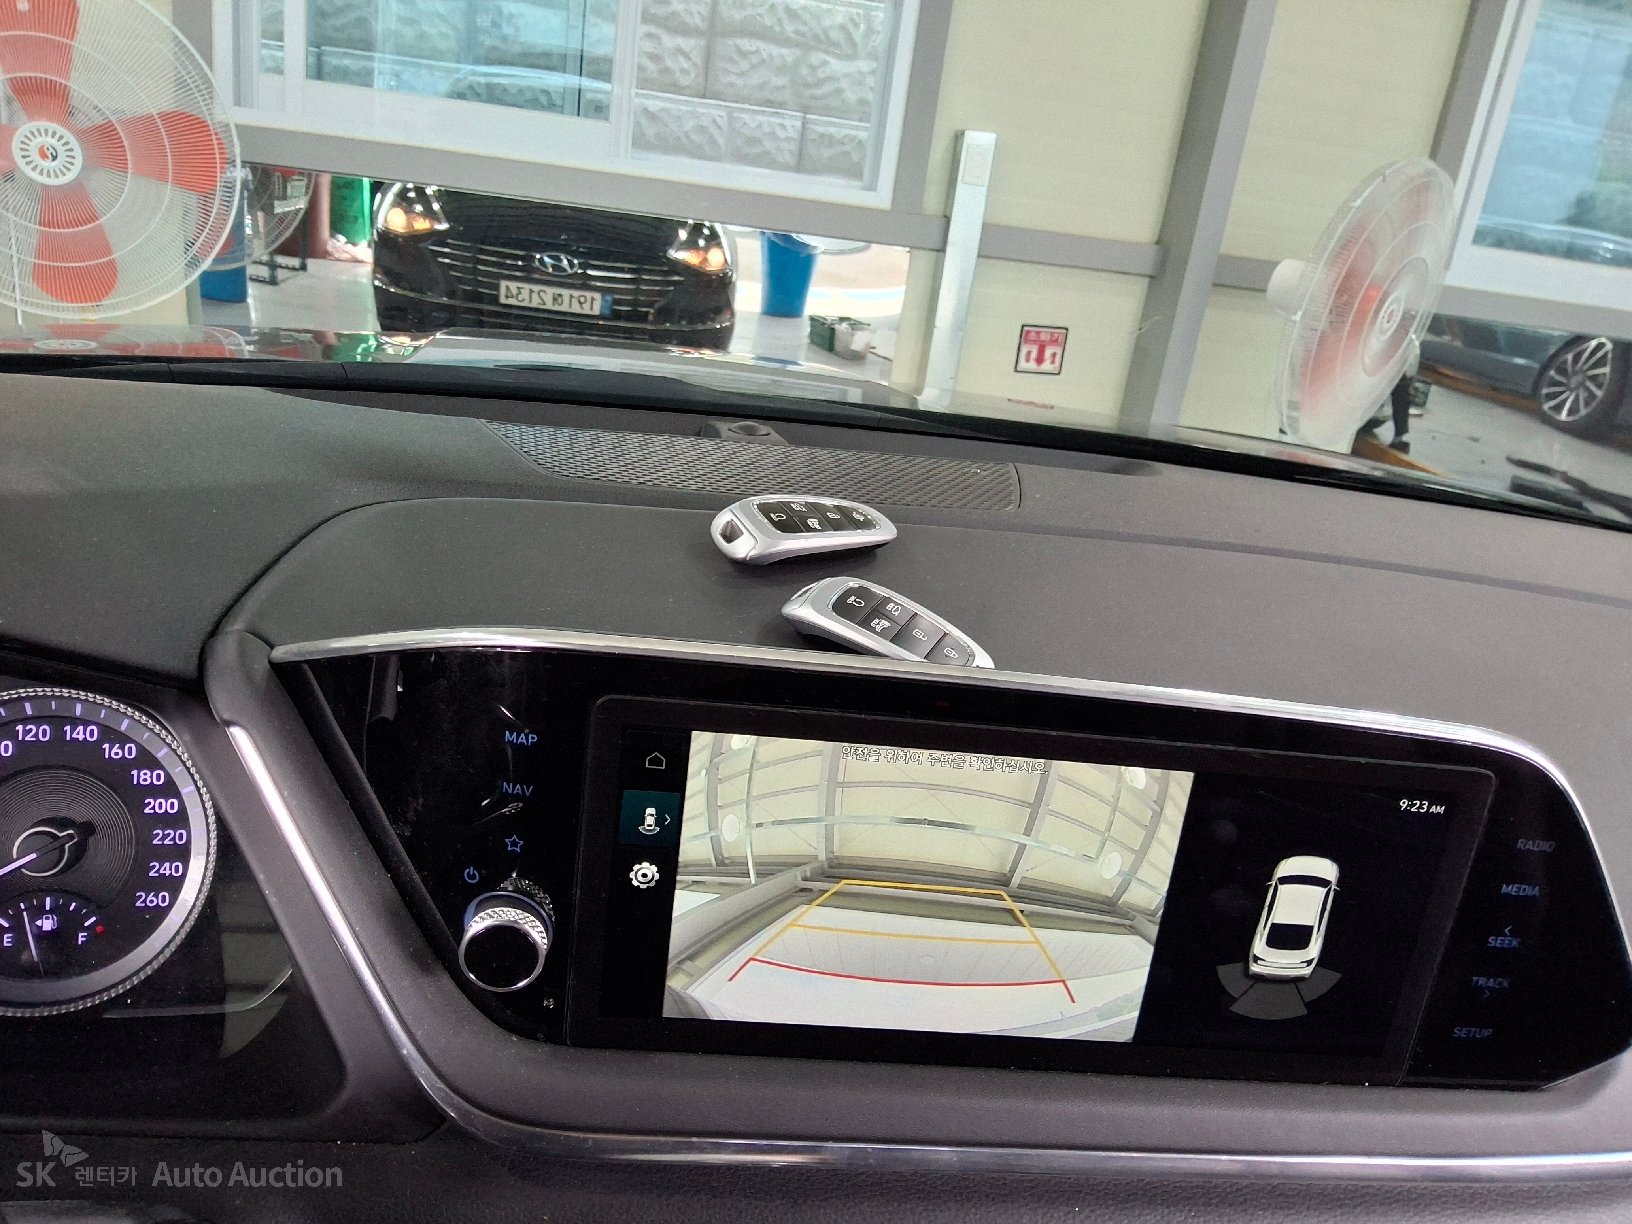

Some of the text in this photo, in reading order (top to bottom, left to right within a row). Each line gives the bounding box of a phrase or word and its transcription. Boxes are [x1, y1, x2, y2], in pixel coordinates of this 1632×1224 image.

[15, 724, 50, 741] 120
[64, 724, 98, 741] 140
[505, 731, 537, 745] MAP
[102, 743, 136, 759] 160
[841, 746, 881, 762] 안전을
[884, 750, 923, 765] 위하여
[927, 753, 966, 768] 주변을
[131, 769, 164, 785] 180
[503, 782, 533, 796] NAV
[144, 798, 178, 815] 200
[1400, 799, 1446, 815] 9:23 AM
[152, 829, 187, 846] 220
[1517, 838, 1555, 851] RADIO
[149, 861, 183, 878] 240
[1501, 884, 1540, 897] MEDIA
[135, 891, 170, 908] 260
[3, 934, 13, 947] E
[78, 933, 88, 946] F
[1488, 936, 1521, 949] SEEK
[1472, 976, 1510, 989] TRACK
[1453, 1027, 1493, 1038] SETUP
